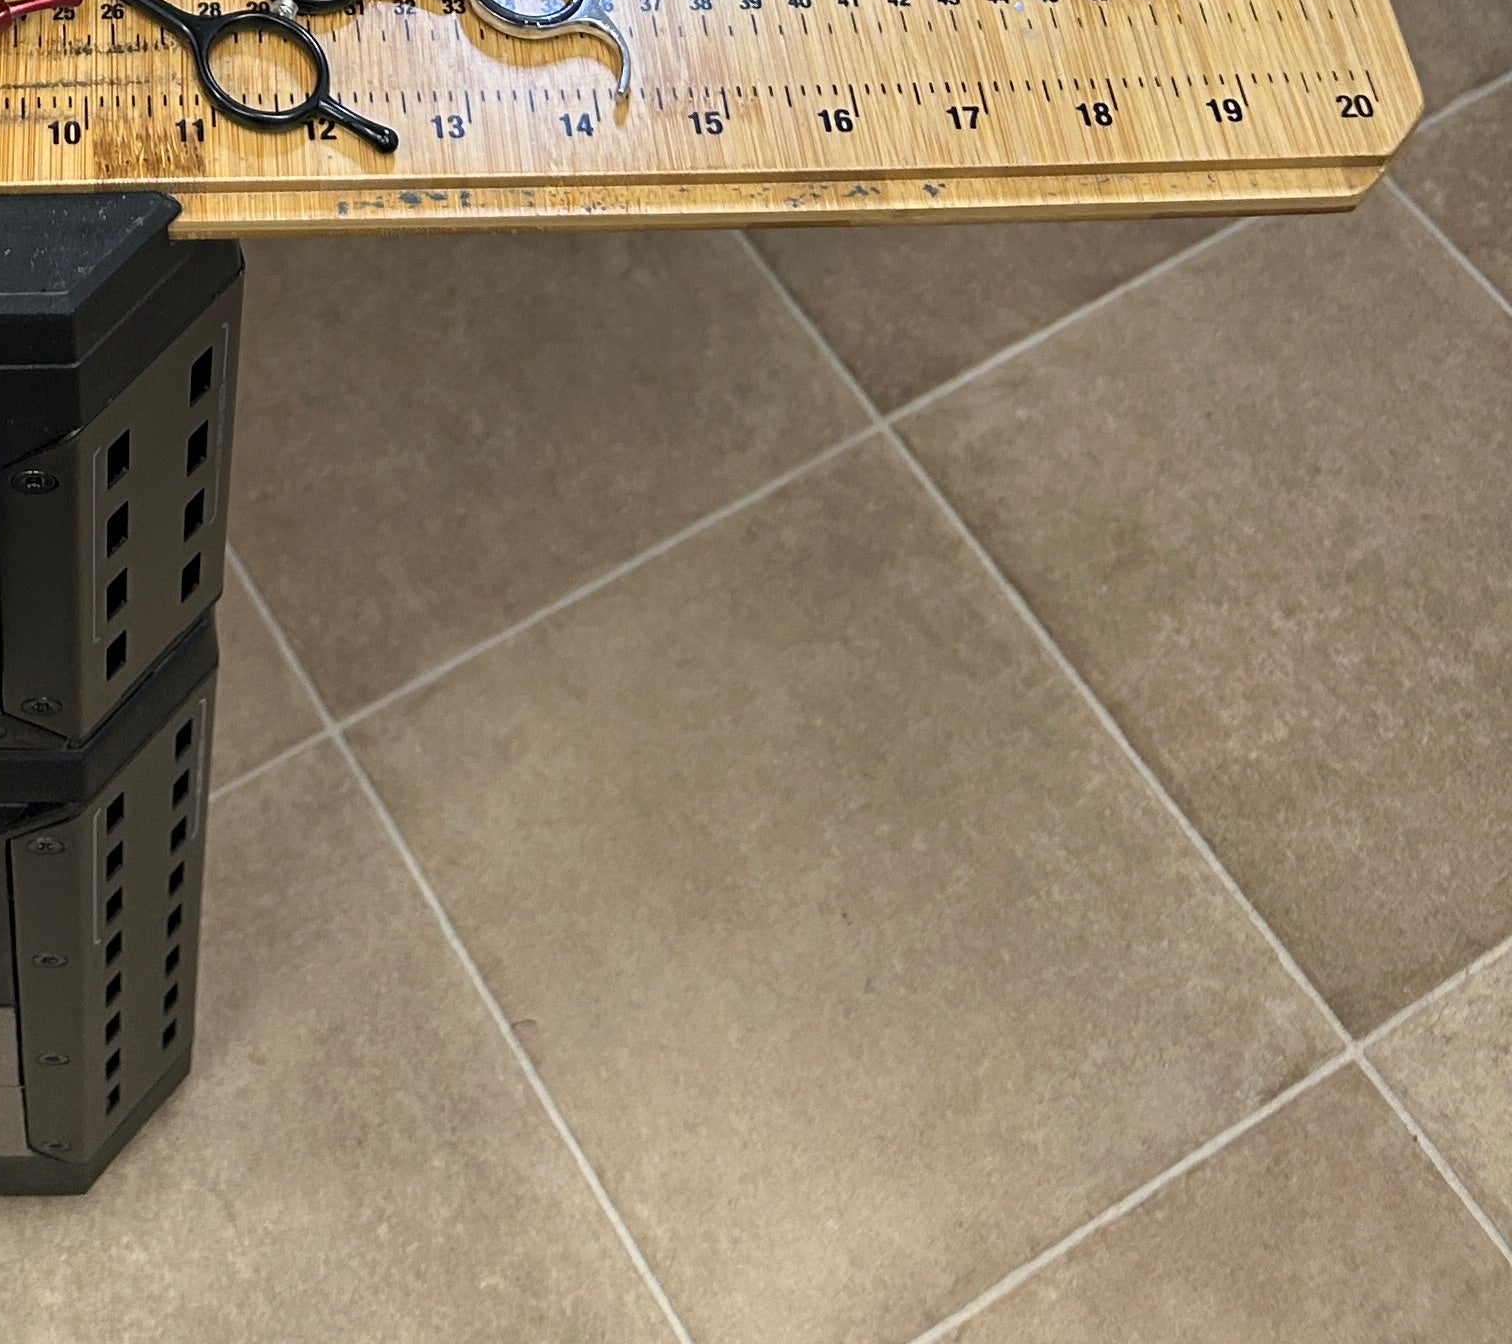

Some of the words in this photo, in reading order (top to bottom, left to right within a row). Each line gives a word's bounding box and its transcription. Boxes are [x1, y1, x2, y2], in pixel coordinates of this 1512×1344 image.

[52, 7, 76, 21] 25
[101, 3, 125, 21] 26
[197, 1, 221, 17] 28
[392, 0, 417, 16] 32
[46, 120, 82, 146] 10
[175, 118, 205, 143] 11
[302, 116, 338, 141] 12
[431, 115, 465, 140] 13
[559, 112, 594, 137] 14
[688, 110, 724, 135] 15
[818, 108, 854, 133] 16
[945, 105, 980, 130] 17
[1076, 102, 1113, 127] 18
[1206, 98, 1243, 123] 19
[1335, 94, 1374, 119] 20
